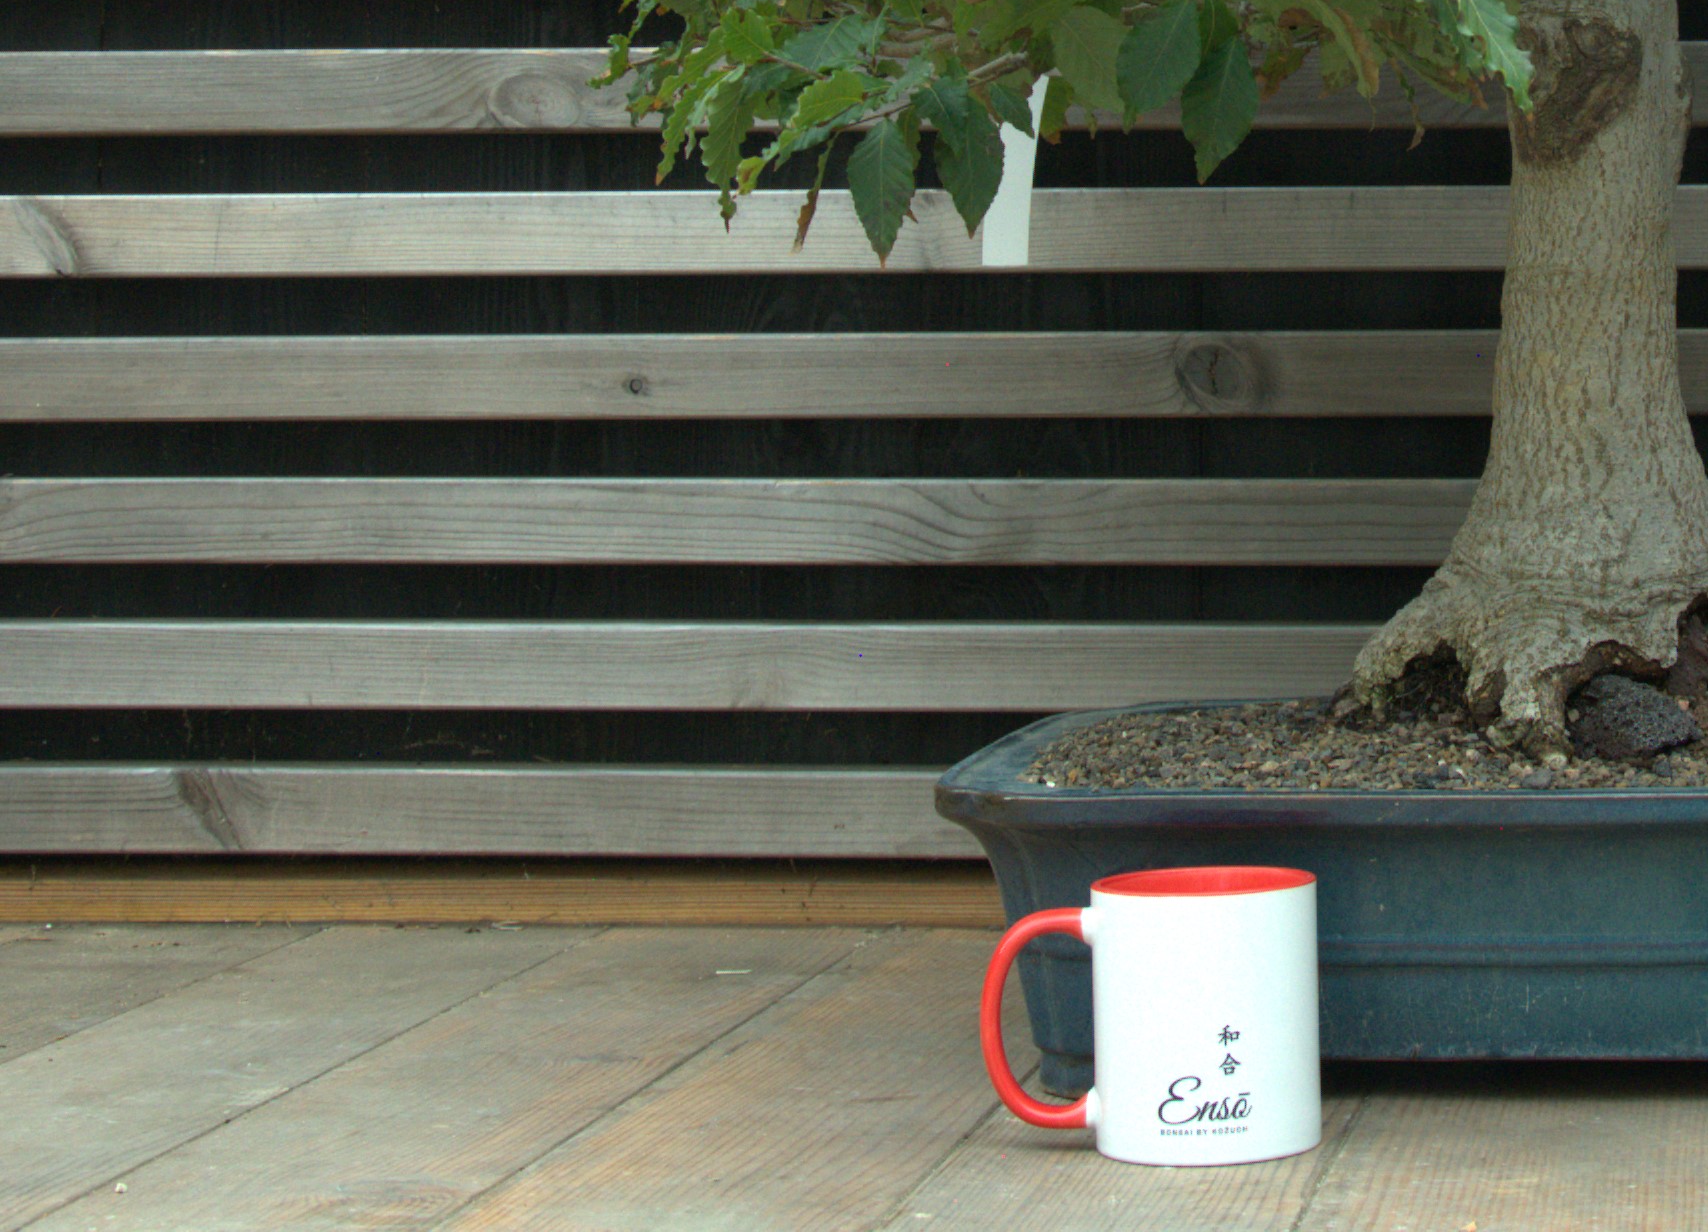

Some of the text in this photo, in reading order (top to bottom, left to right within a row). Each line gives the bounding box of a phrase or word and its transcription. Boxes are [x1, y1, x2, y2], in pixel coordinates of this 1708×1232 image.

[1218, 1025, 1241, 1076] 和合
[1160, 1128, 1193, 1136] BONSAI
[1196, 1128, 1207, 1136] BY
